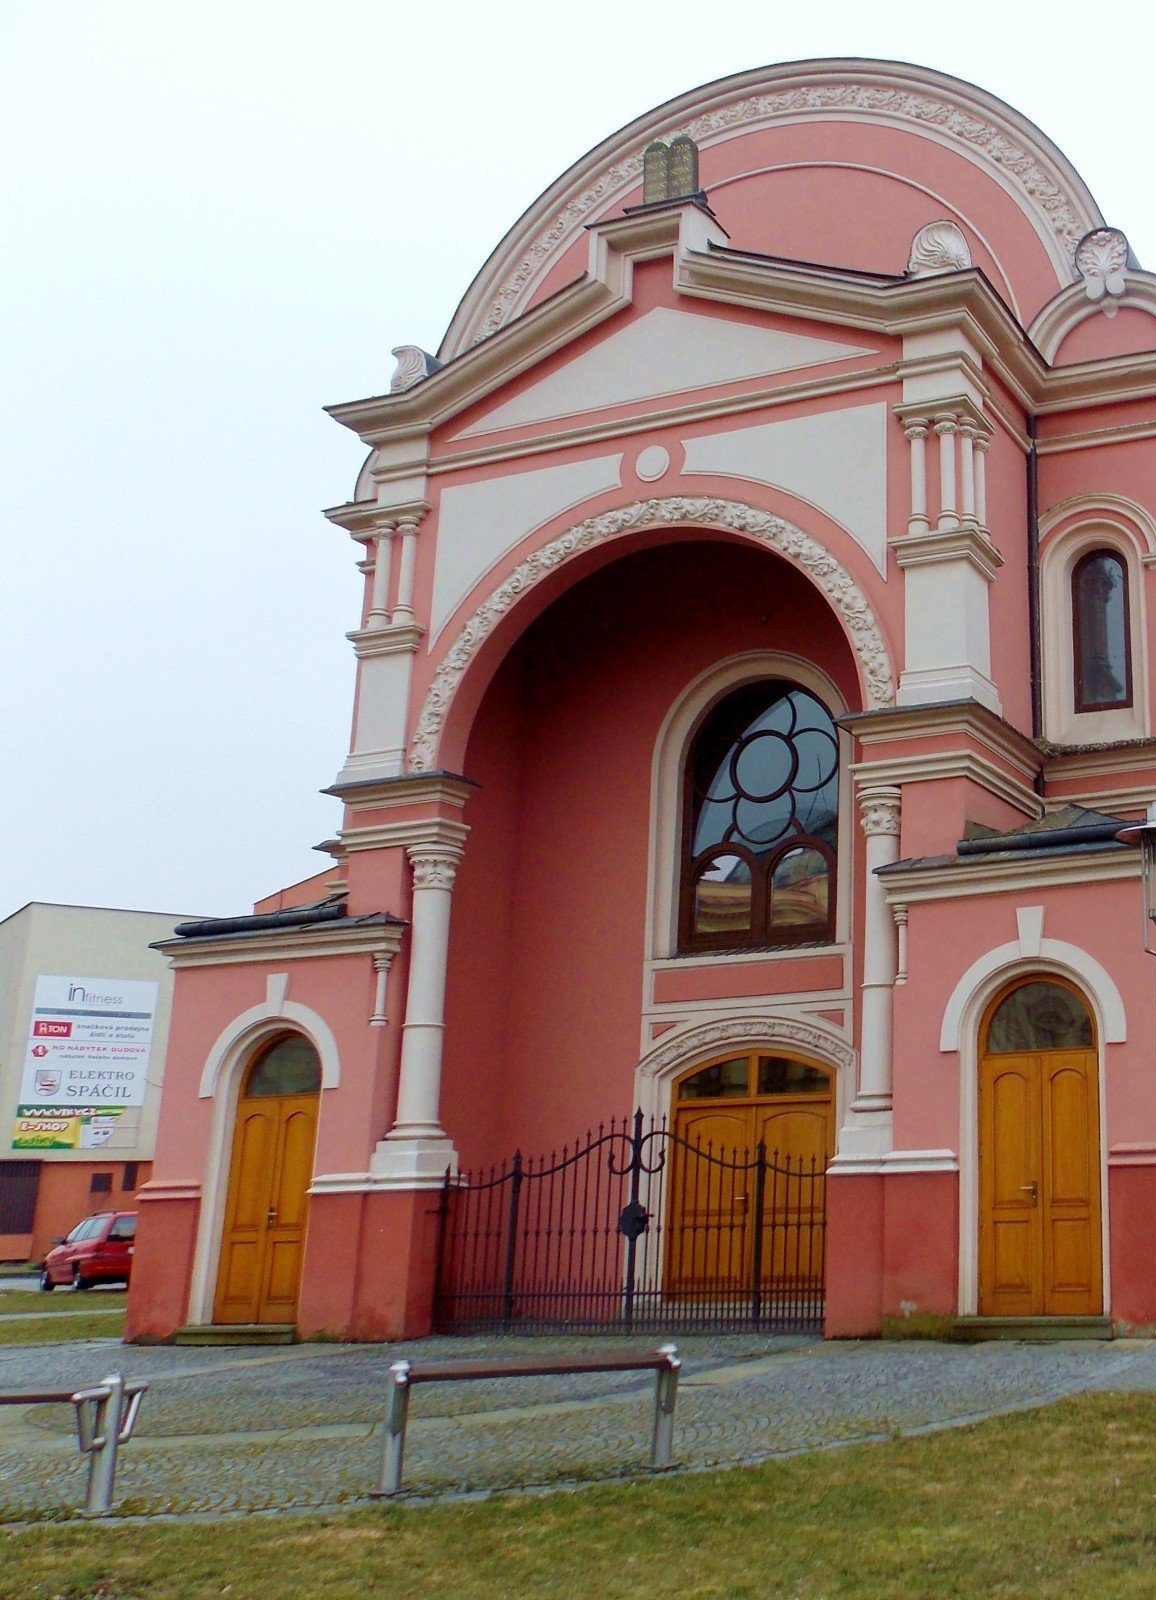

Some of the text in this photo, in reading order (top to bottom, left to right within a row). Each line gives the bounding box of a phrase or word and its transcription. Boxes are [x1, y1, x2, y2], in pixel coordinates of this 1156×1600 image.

[48, 1024, 68, 1034] TON
[69, 1069, 135, 1081] ELEKTRO
[66, 1083, 132, 1098] SPÁČIL
[20, 1121, 69, 1132] E-SHOP
